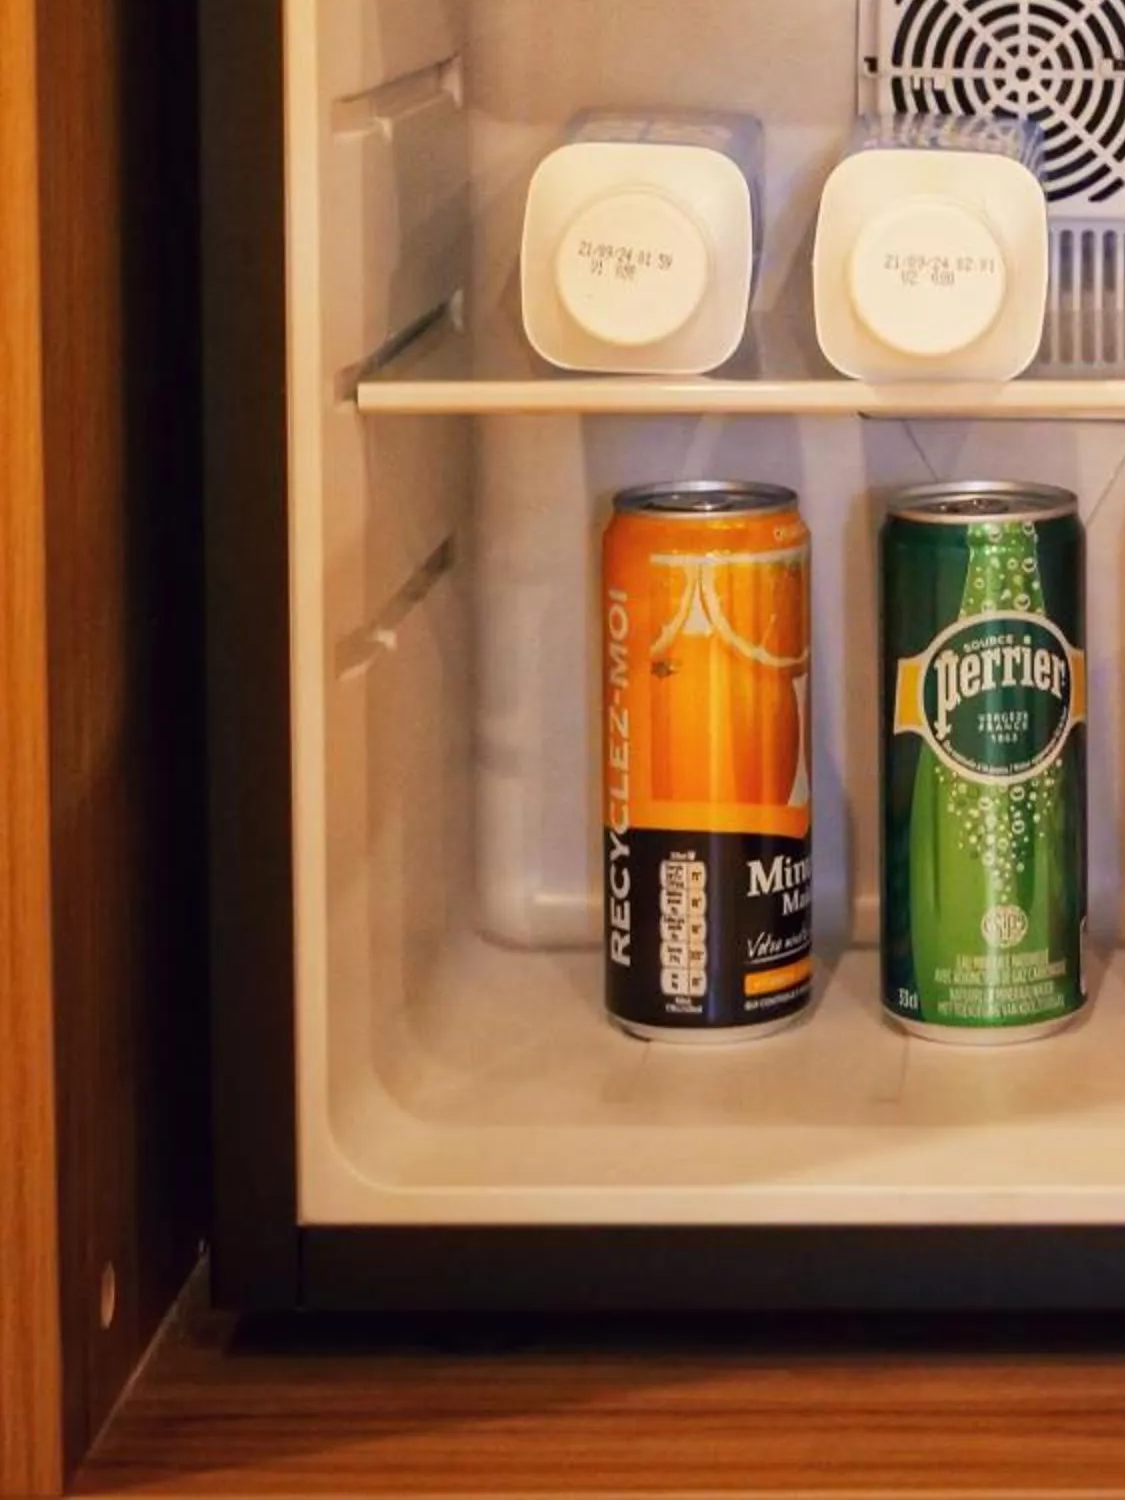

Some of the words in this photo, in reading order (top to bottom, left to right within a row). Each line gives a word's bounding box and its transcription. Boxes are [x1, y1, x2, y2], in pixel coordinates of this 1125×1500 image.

[963, 633, 1014, 653] SOURCE
[934, 646, 1065, 739] Perrier
[608, 589, 631, 967] RECYCLEZ-MOI
